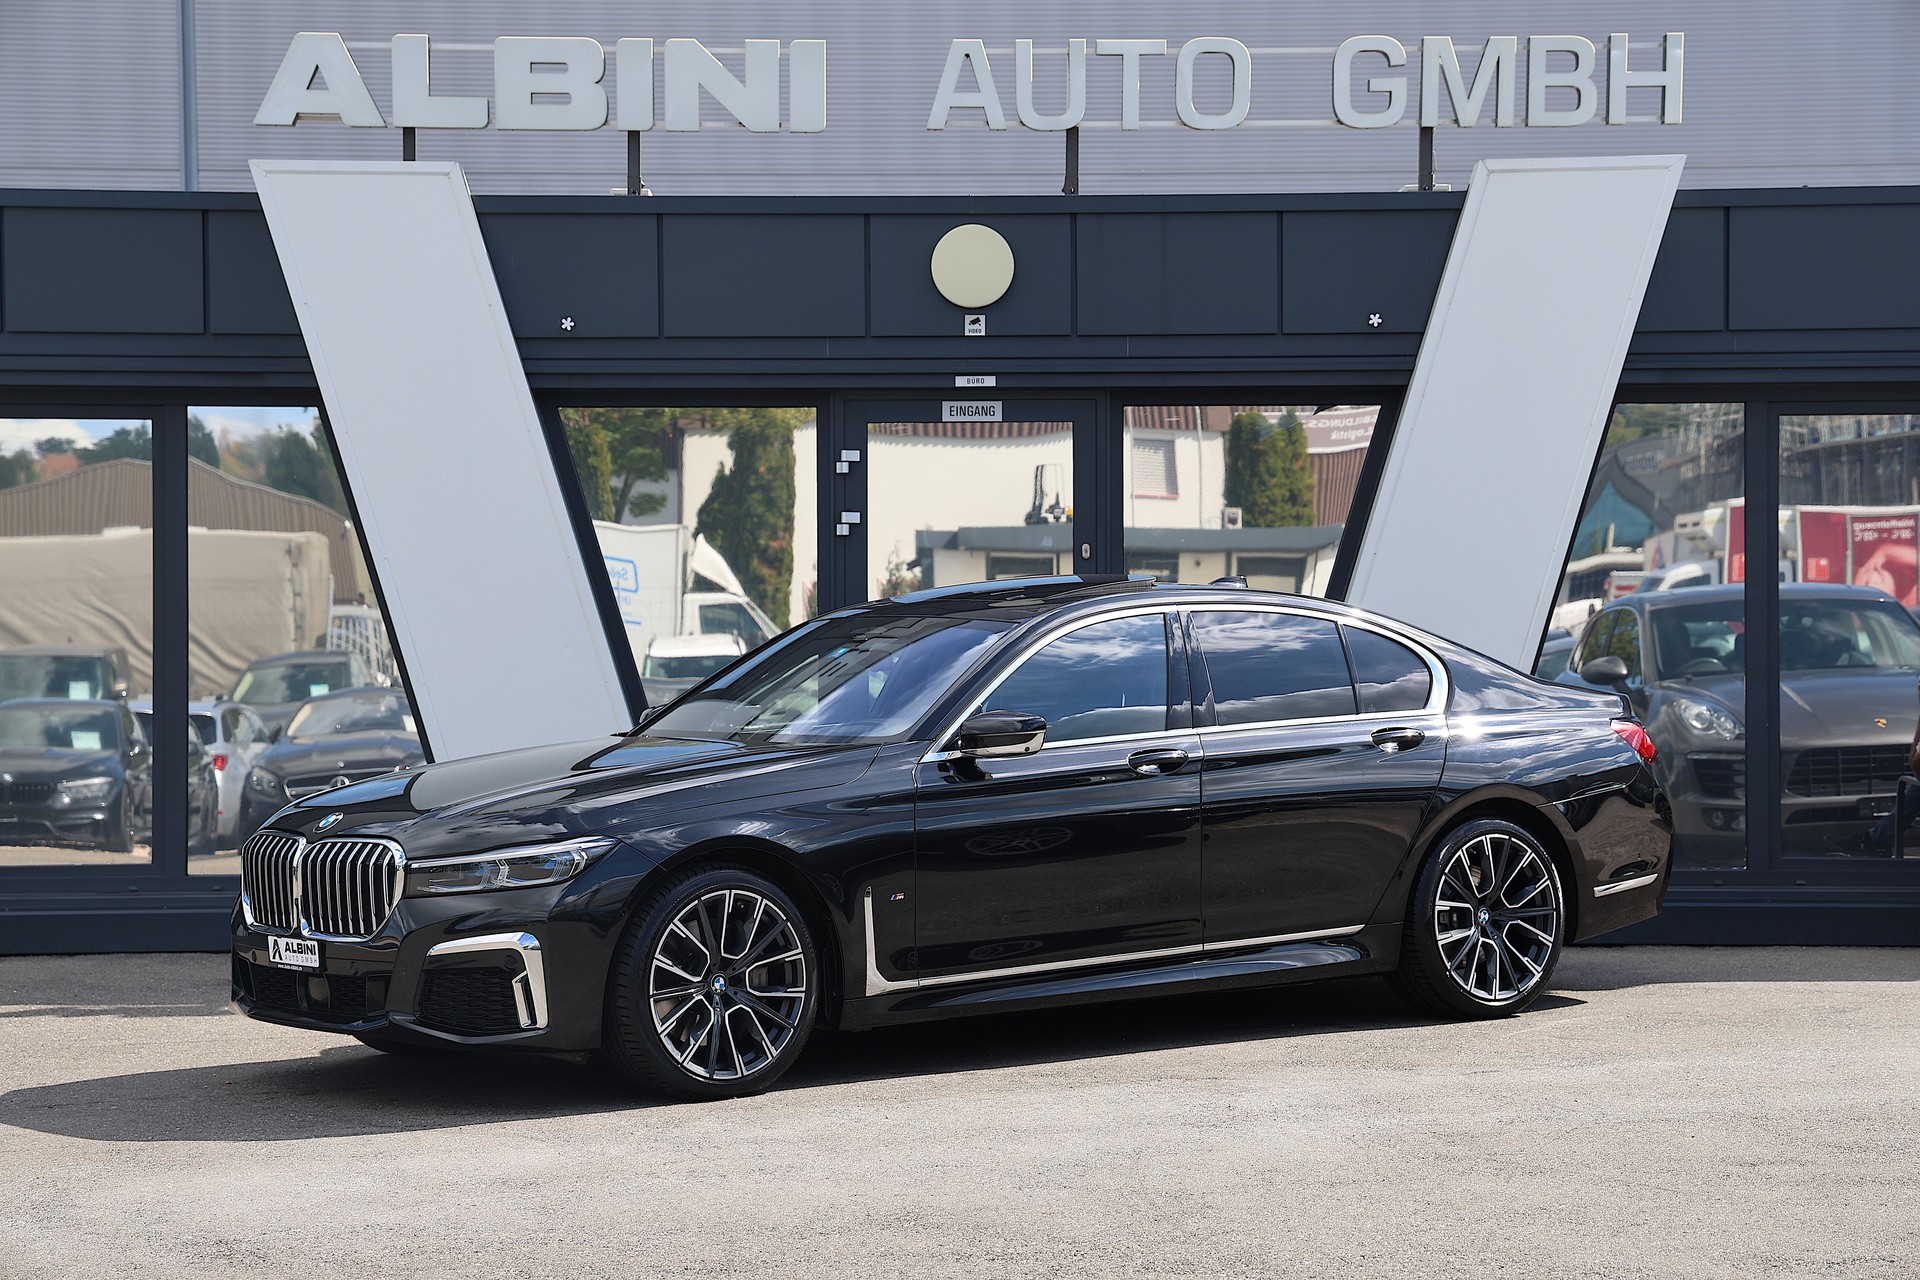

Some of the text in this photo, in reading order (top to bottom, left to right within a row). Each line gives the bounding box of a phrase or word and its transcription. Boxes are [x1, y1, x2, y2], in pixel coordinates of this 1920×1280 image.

[253, 32, 1685, 132] ALBINI AUTO GMBH
[966, 377, 985, 385] BÜRO
[949, 405, 996, 417] EINGANG
[285, 941, 316, 955] ALBINI
[285, 954, 317, 964] AUTO GMBH
